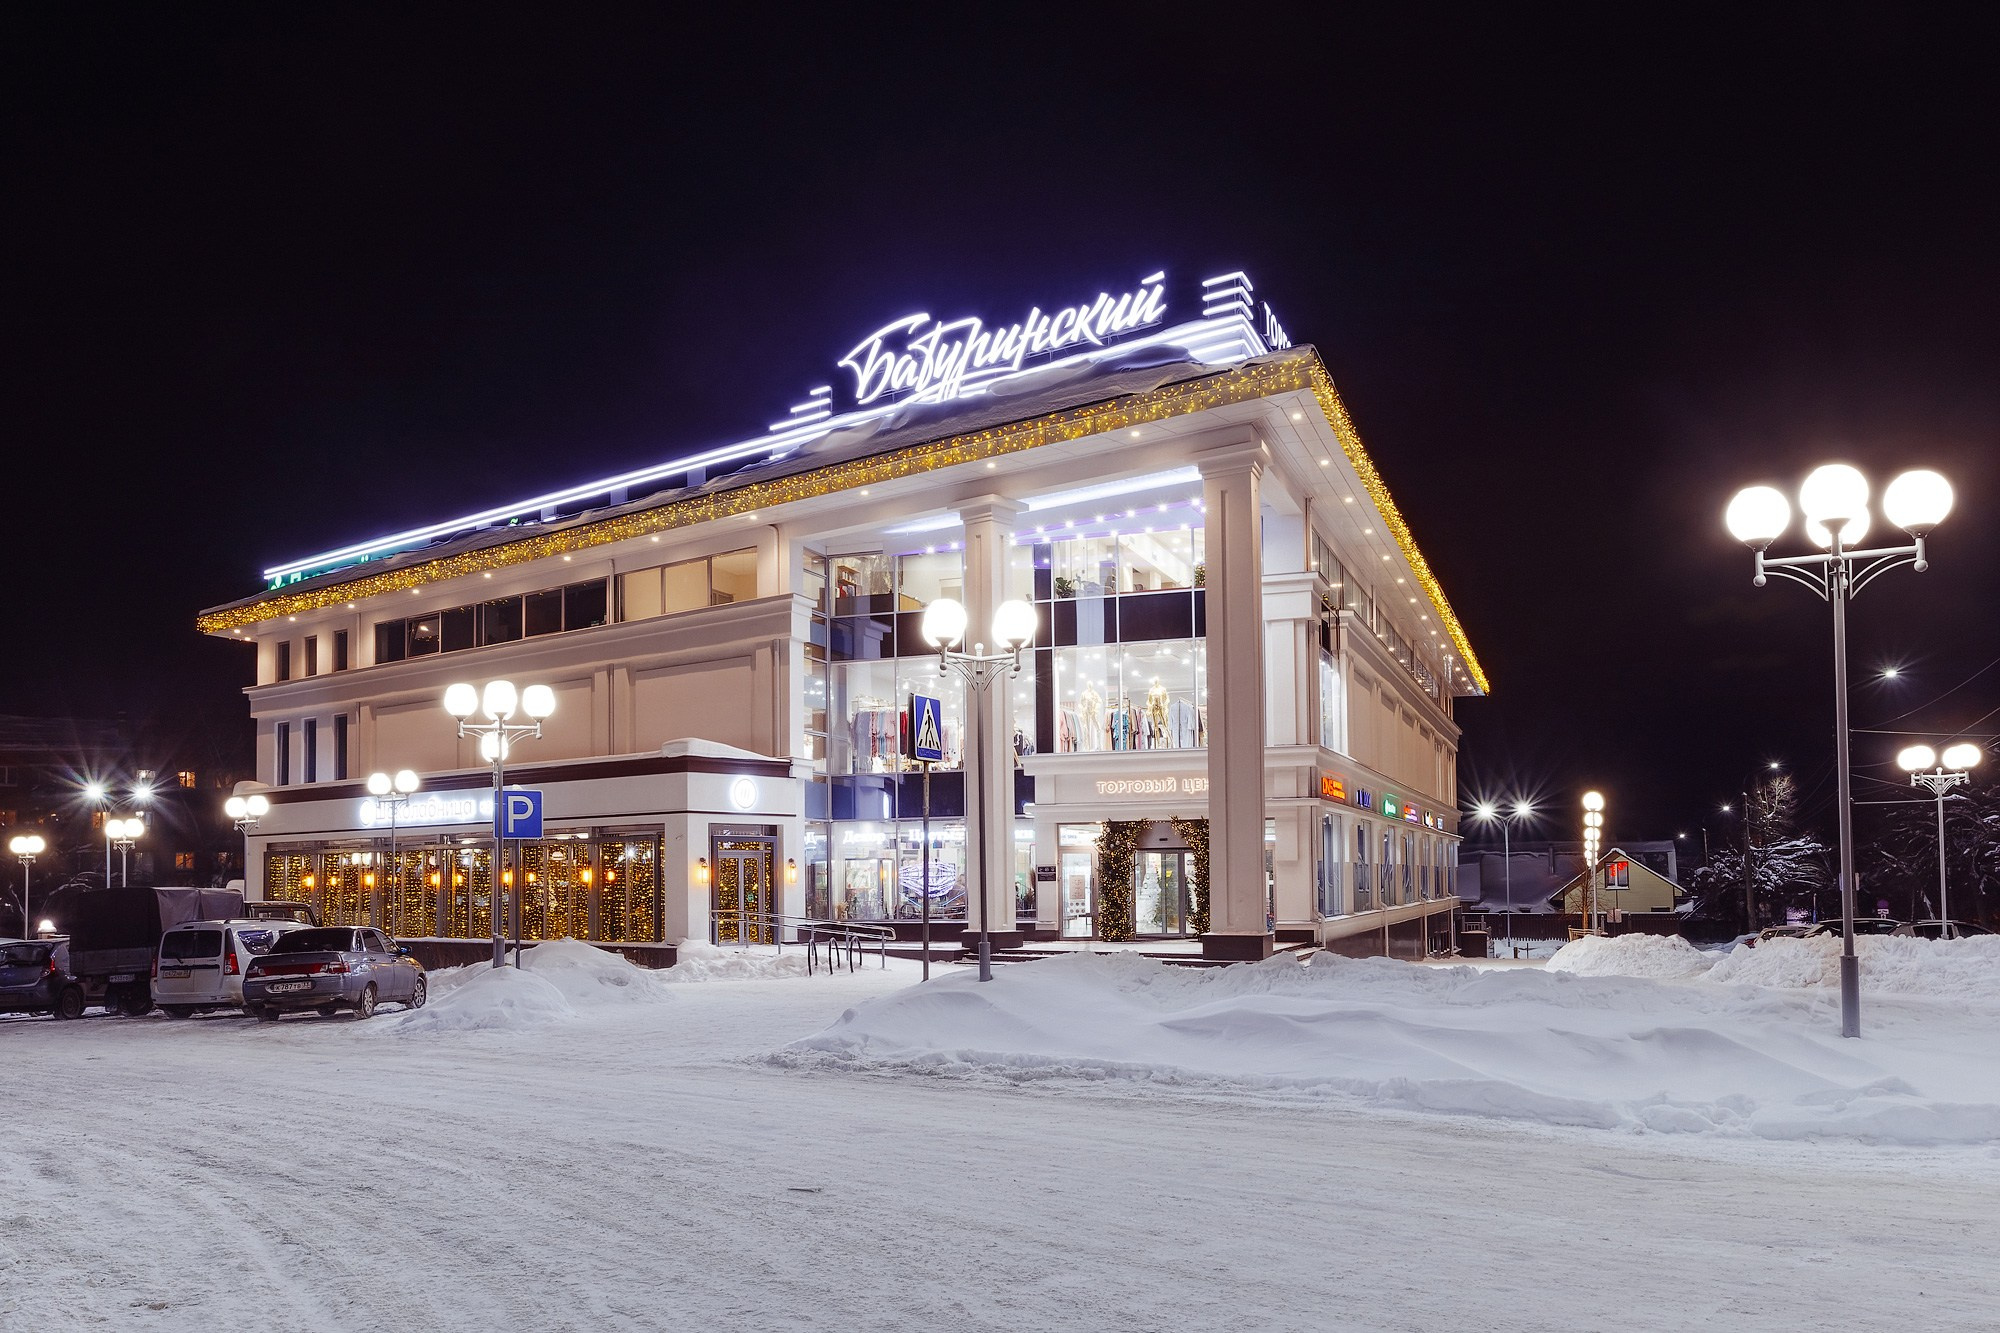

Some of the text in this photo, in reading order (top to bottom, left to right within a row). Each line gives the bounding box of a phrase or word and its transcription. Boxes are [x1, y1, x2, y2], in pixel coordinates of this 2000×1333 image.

[838, 270, 1167, 403] Батуринский
[1096, 777, 1177, 795] ТОРГОВЫЙ
[507, 795, 534, 834] P
